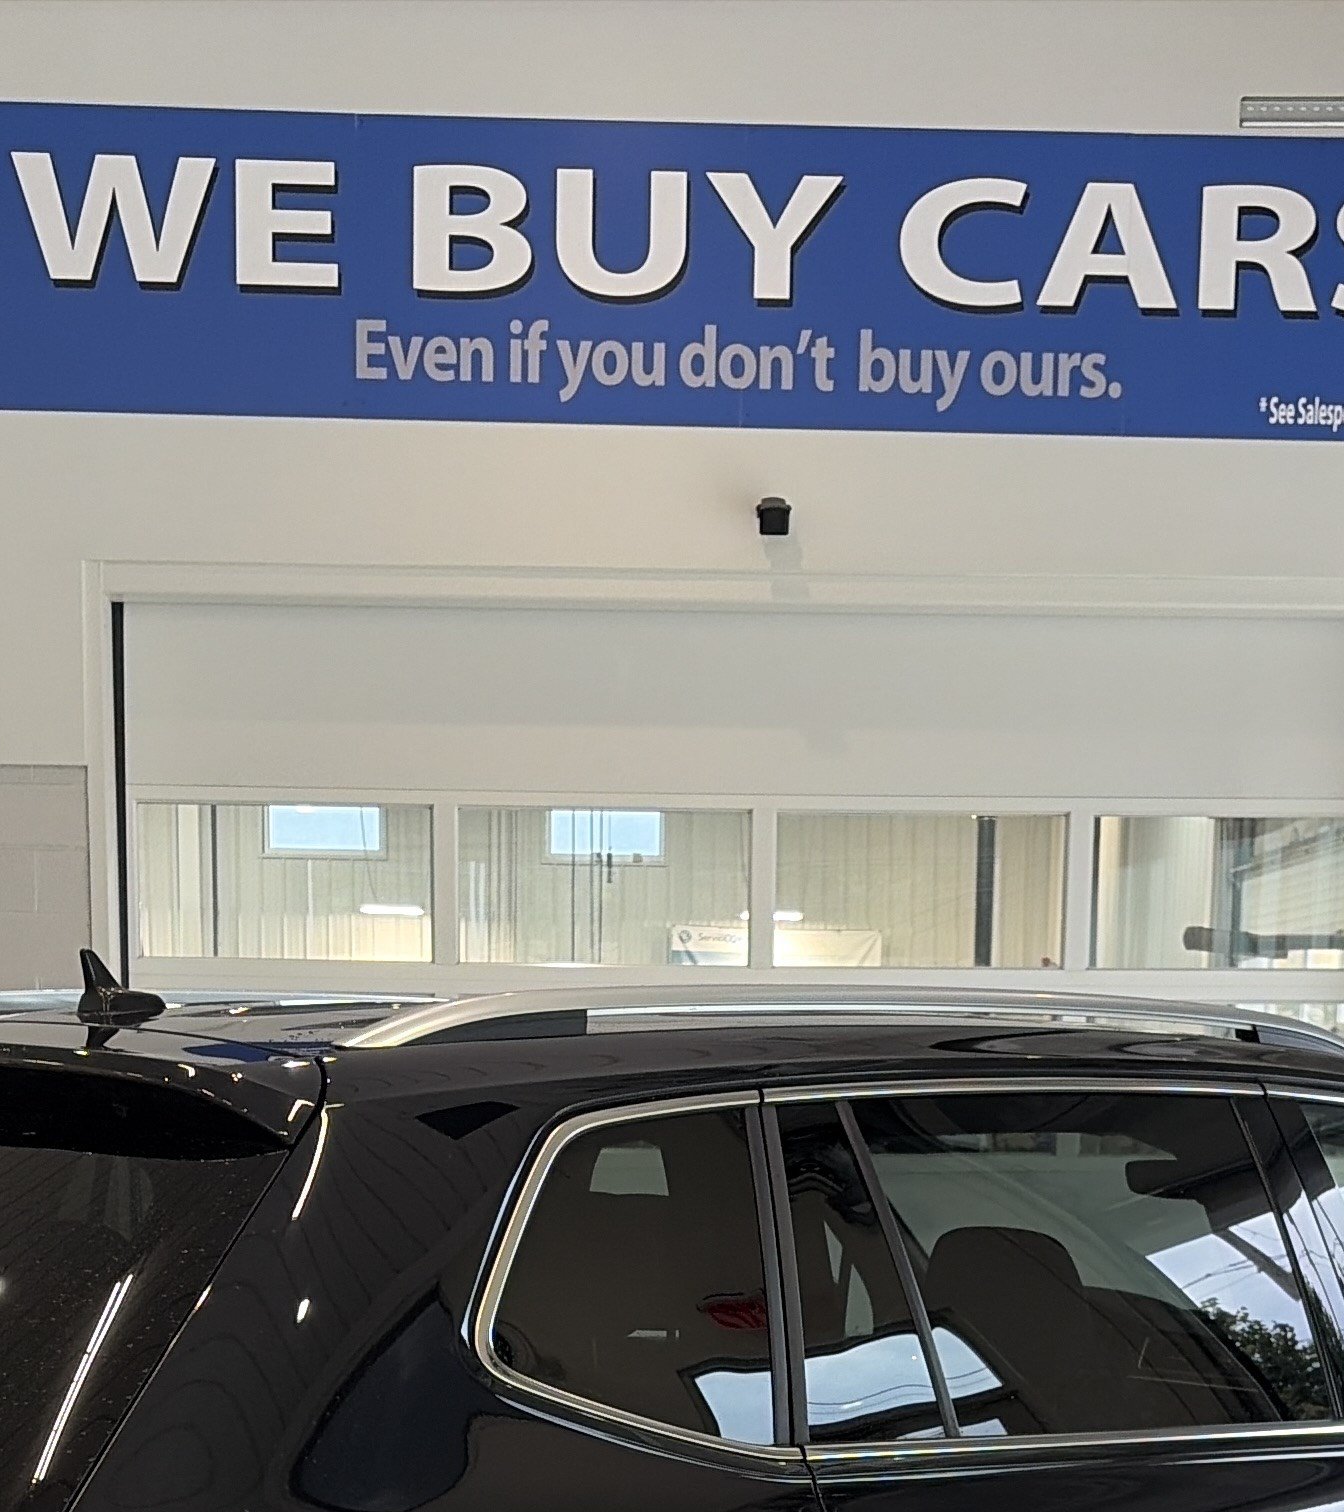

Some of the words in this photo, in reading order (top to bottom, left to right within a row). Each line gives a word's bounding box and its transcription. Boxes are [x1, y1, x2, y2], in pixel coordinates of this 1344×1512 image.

[10, 151, 341, 295] WE
[412, 163, 846, 308] BUY
[355, 319, 494, 382] Even
[509, 319, 549, 383] if
[556, 340, 665, 403] you
[679, 324, 835, 392] don’t
[859, 328, 970, 413] buy
[980, 350, 1122, 399] ours.
